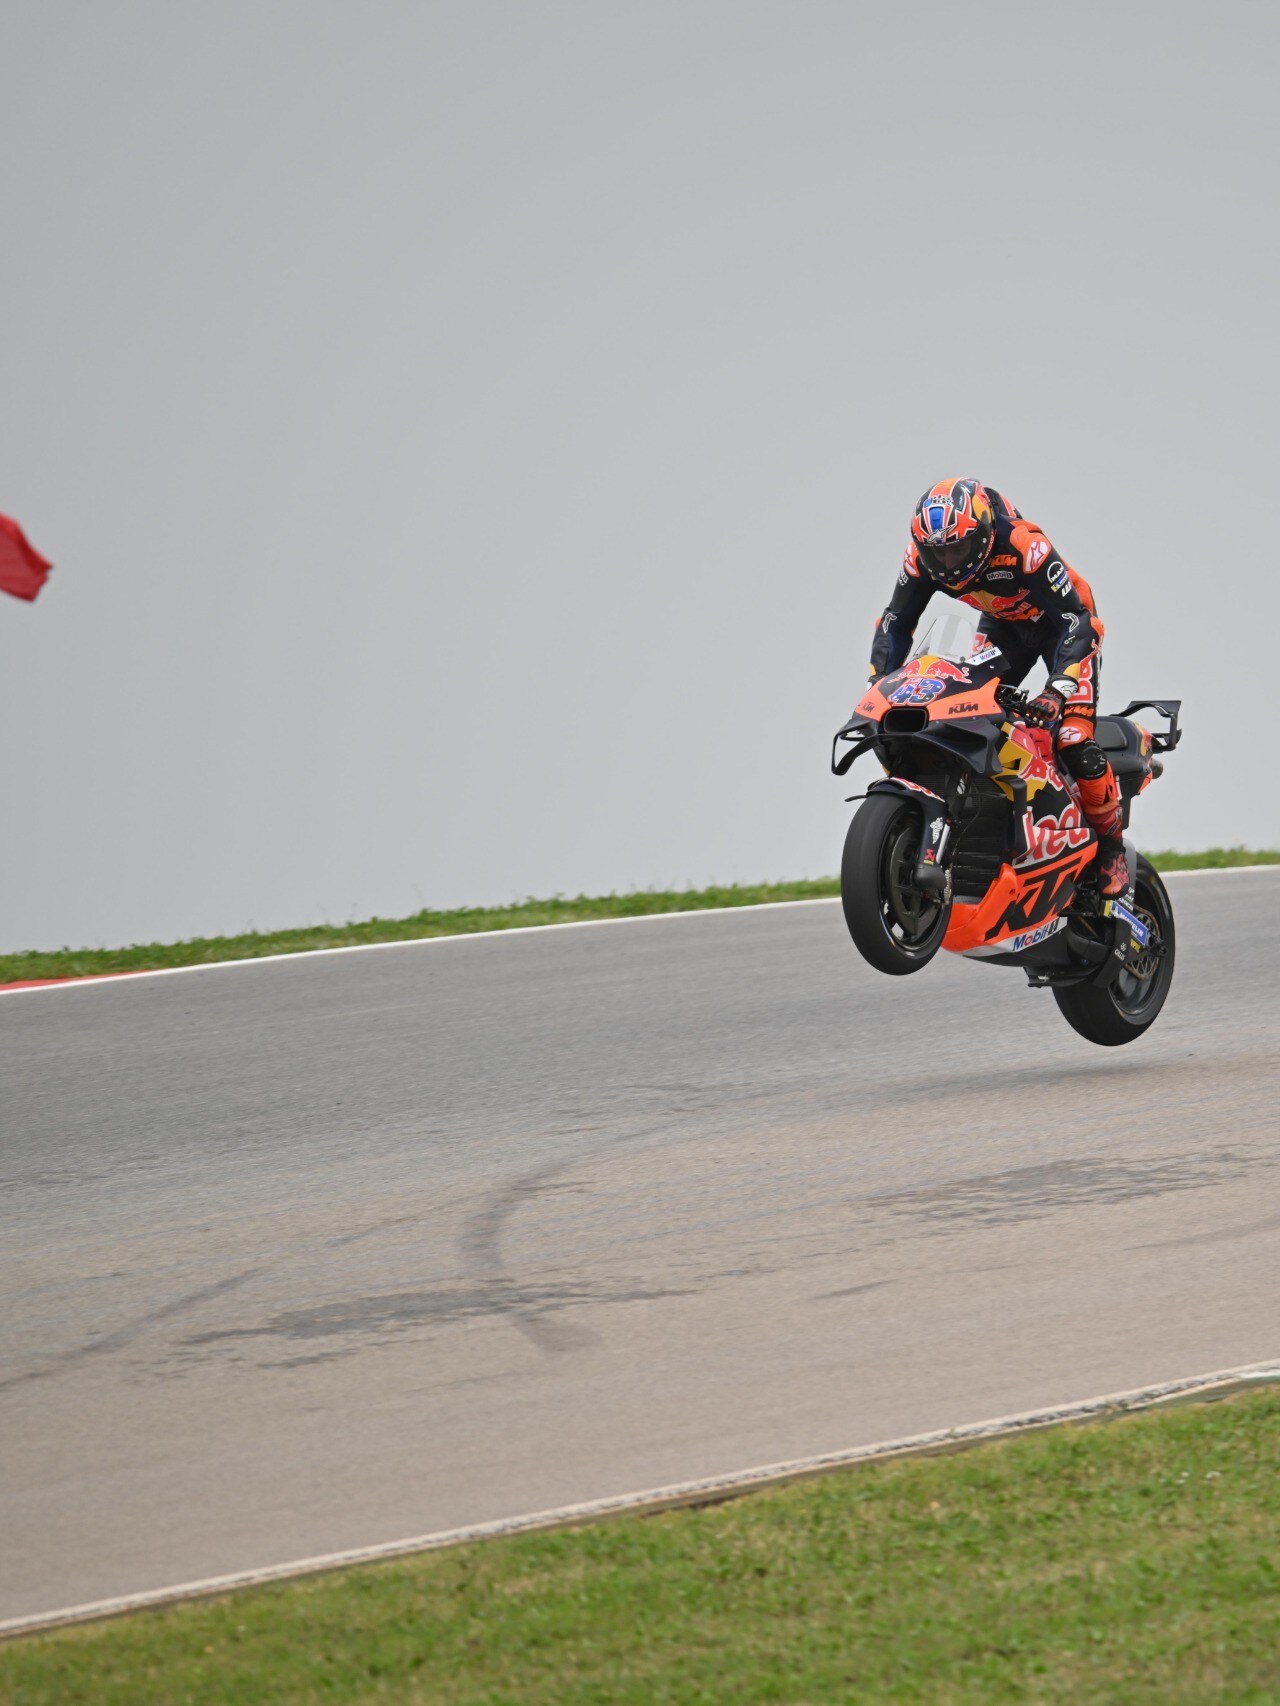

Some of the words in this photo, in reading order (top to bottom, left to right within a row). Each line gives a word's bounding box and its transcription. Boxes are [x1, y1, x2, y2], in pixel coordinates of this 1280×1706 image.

[887, 678, 946, 707] 43
[947, 702, 979, 715] KTM
[984, 856, 1083, 942] KTM
[1012, 926, 1049, 952] Mobil
